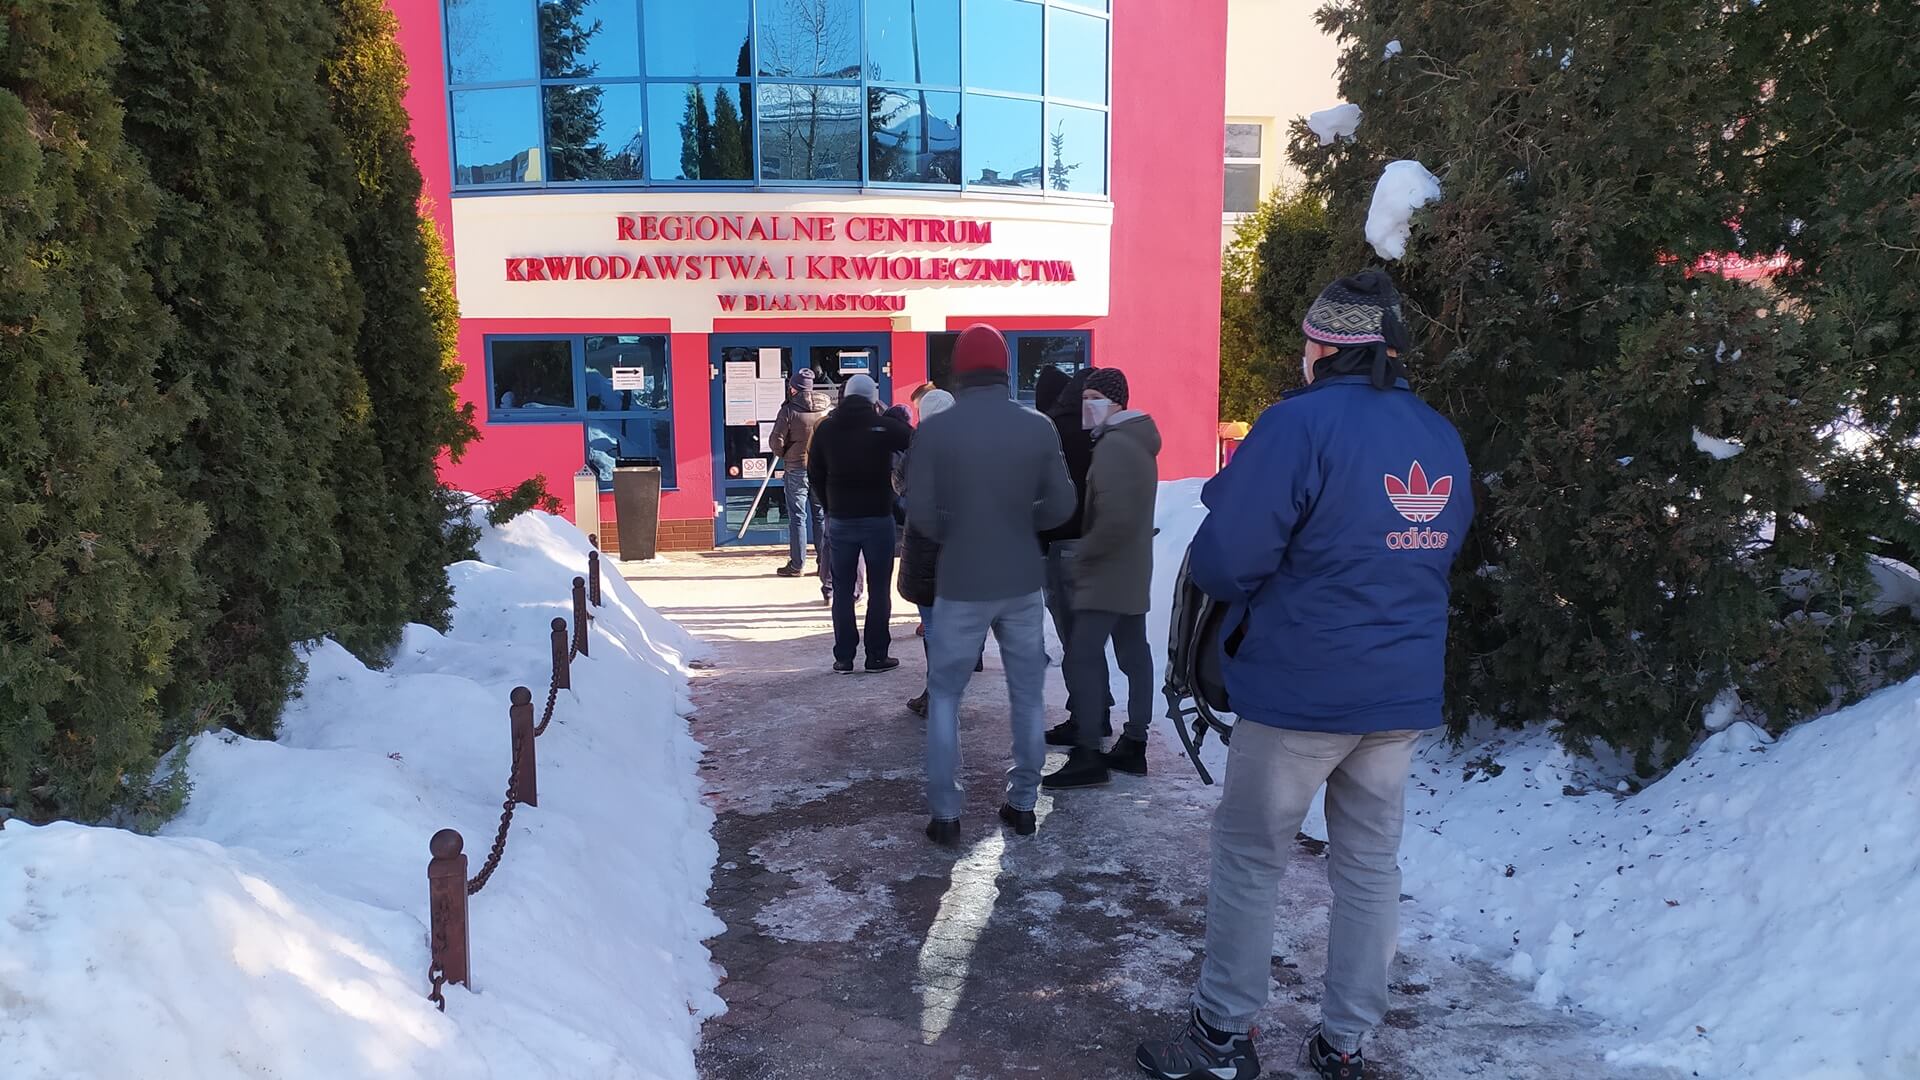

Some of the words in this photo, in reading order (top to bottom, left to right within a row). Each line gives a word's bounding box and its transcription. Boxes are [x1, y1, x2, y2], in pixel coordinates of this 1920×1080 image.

[616, 215, 836, 242] REGIONALNE
[844, 217, 993, 244] CENTRUM
[505, 255, 776, 282] KRWIODAWSTWA
[785, 255, 795, 280] I
[805, 255, 1077, 282] KRWIOLECZNICTWA
[717, 294, 738, 311] W
[744, 294, 906, 311] BIAŁYMSTOKU
[1385, 526, 1449, 550] adidas
